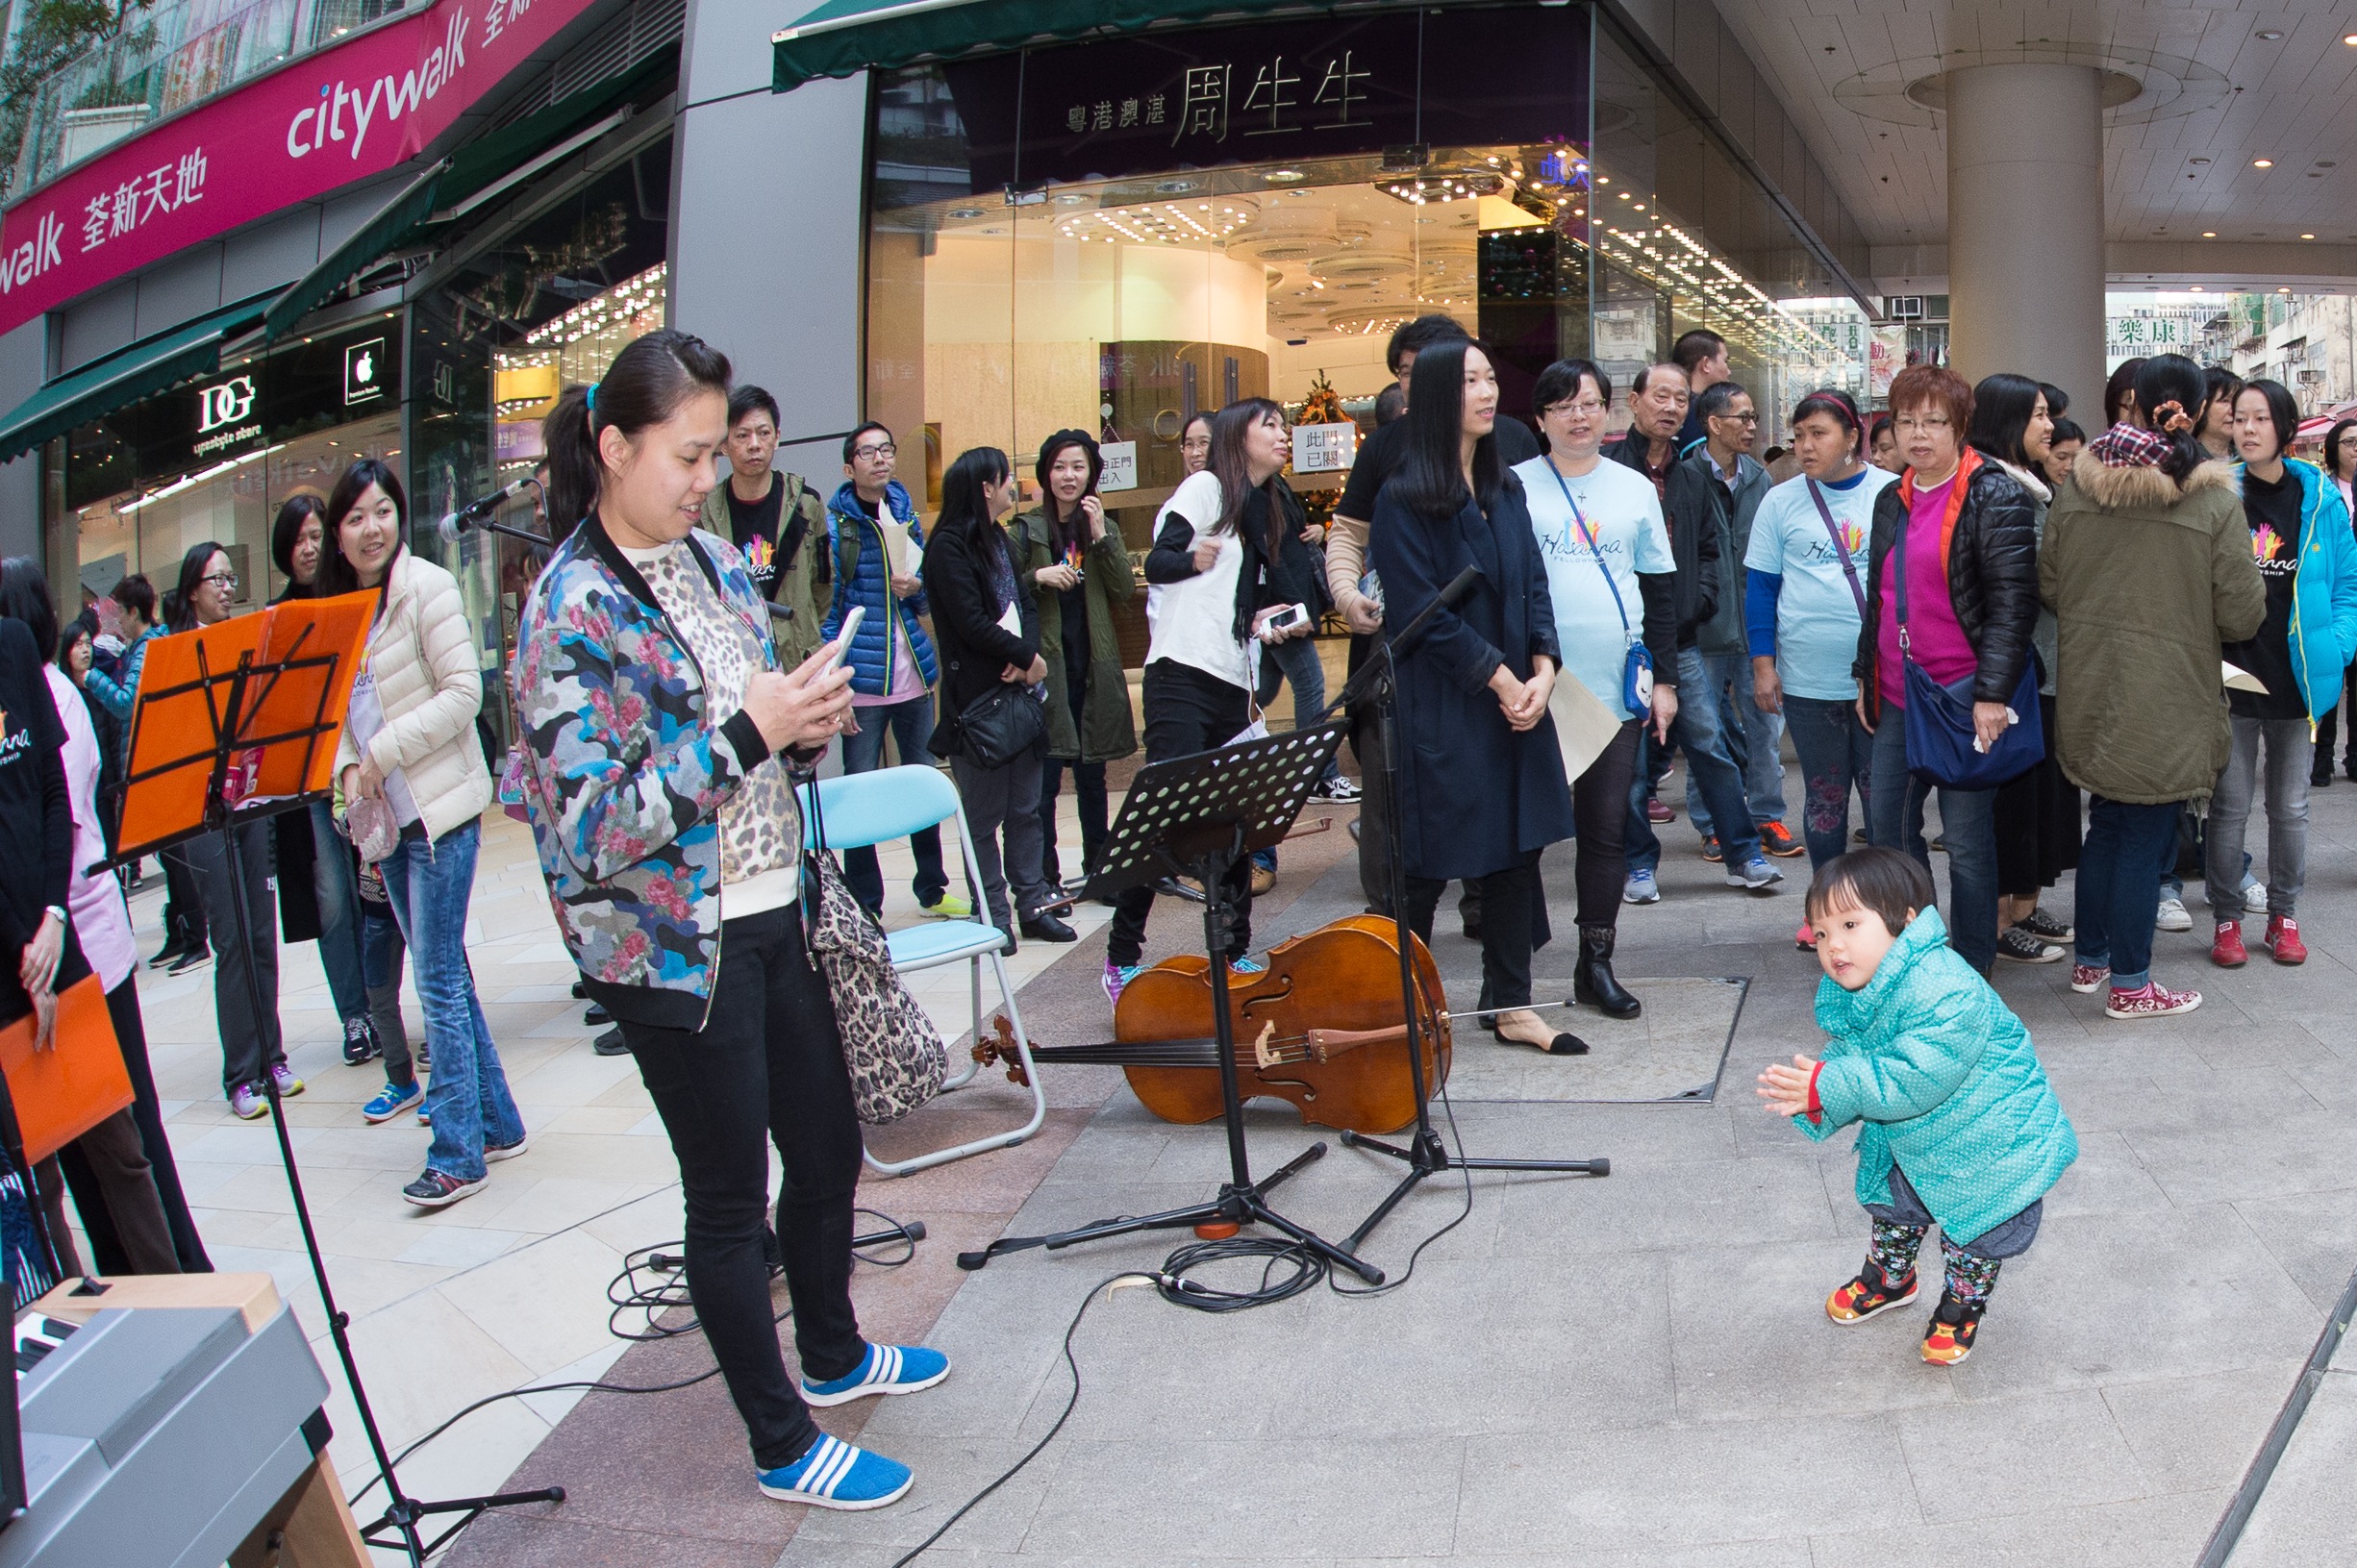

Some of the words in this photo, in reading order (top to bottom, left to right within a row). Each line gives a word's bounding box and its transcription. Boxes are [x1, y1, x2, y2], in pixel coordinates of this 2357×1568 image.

[288, 6, 470, 160] citywalk
[1171, 50, 1373, 148] 周生生
[81, 146, 207, 253] 荃新天地
[2106, 318, 2175, 344] 樂康
[198, 375, 256, 434] DG
[1306, 430, 1338, 448] 此門
